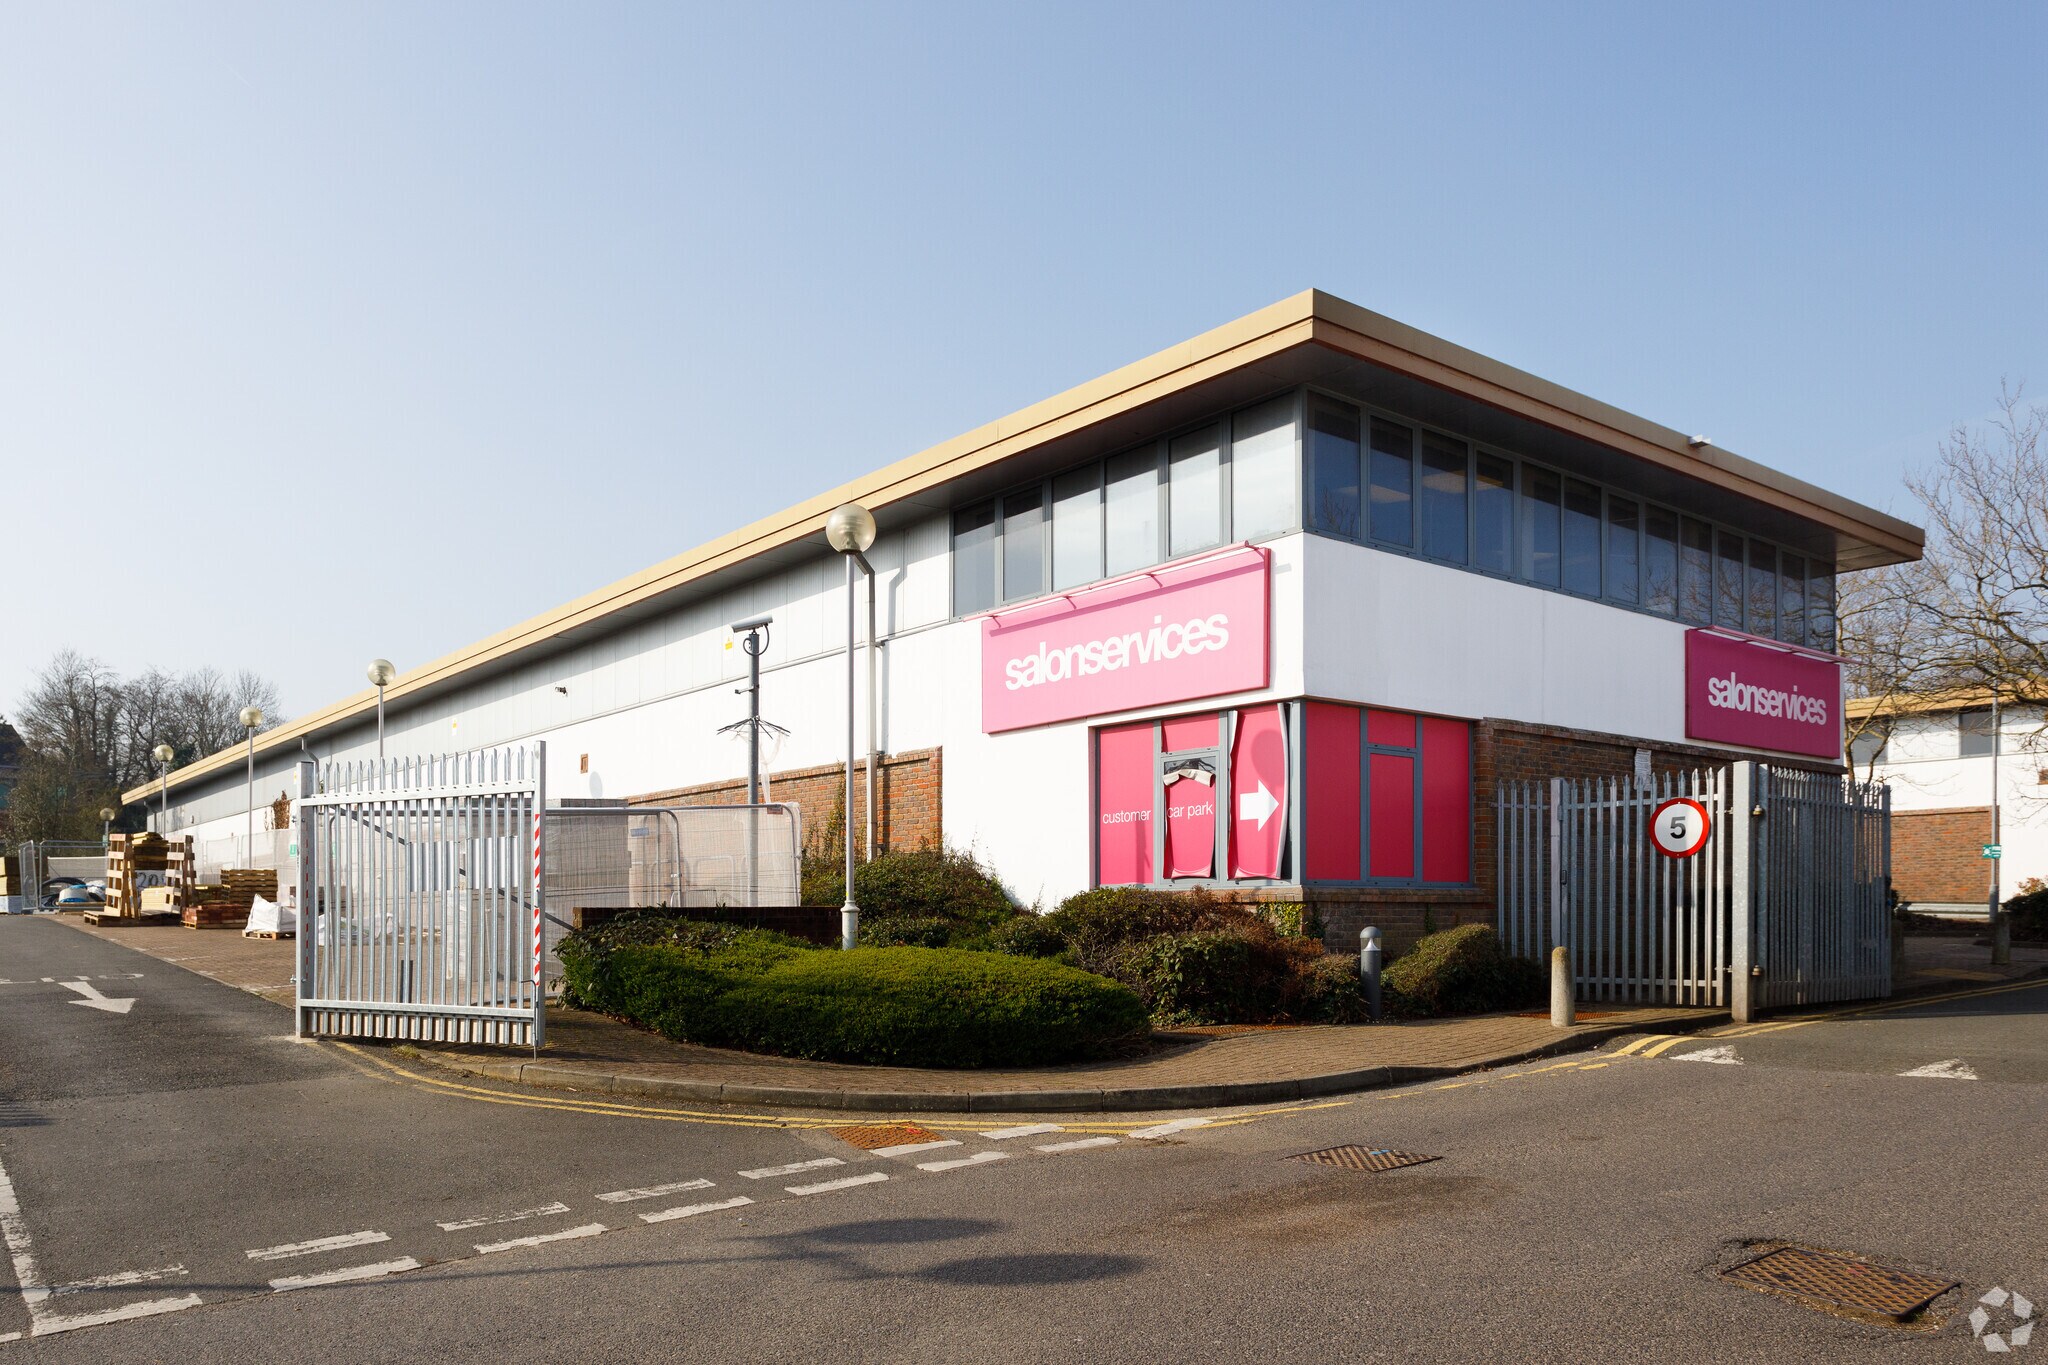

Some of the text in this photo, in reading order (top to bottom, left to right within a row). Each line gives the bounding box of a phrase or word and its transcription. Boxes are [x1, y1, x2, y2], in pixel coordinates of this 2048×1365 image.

[1005, 613, 1229, 691] salonservices
[1708, 671, 1827, 725] salonservices
[1102, 801, 1213, 824] customer car park
[1670, 816, 1686, 839] 5
